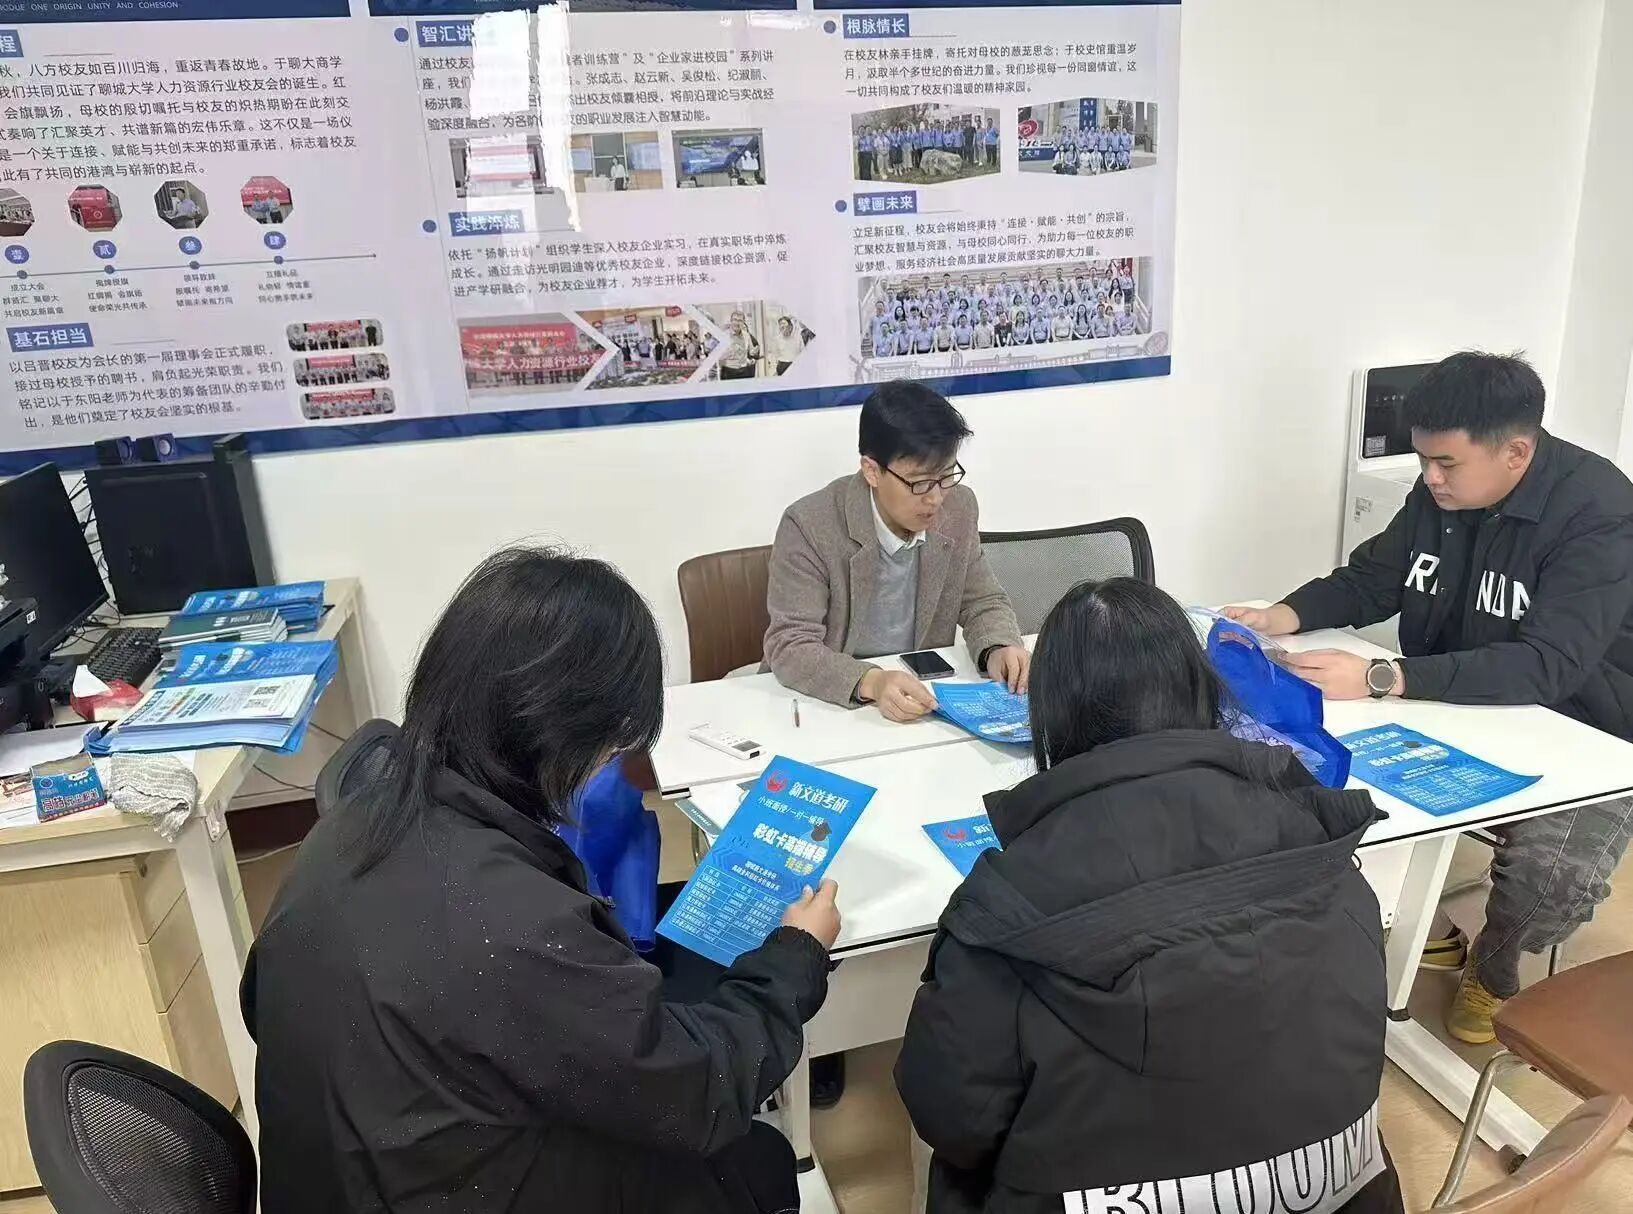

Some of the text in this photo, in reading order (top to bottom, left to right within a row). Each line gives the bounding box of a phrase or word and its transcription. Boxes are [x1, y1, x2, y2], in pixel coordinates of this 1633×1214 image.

[422, 26, 473, 44] 智汇讲
[847, 18, 905, 36] 根脉情长
[858, 195, 913, 213] 擘画未来
[14, 328, 87, 348] 基石担当
[789, 782, 849, 814] 新文道考研
